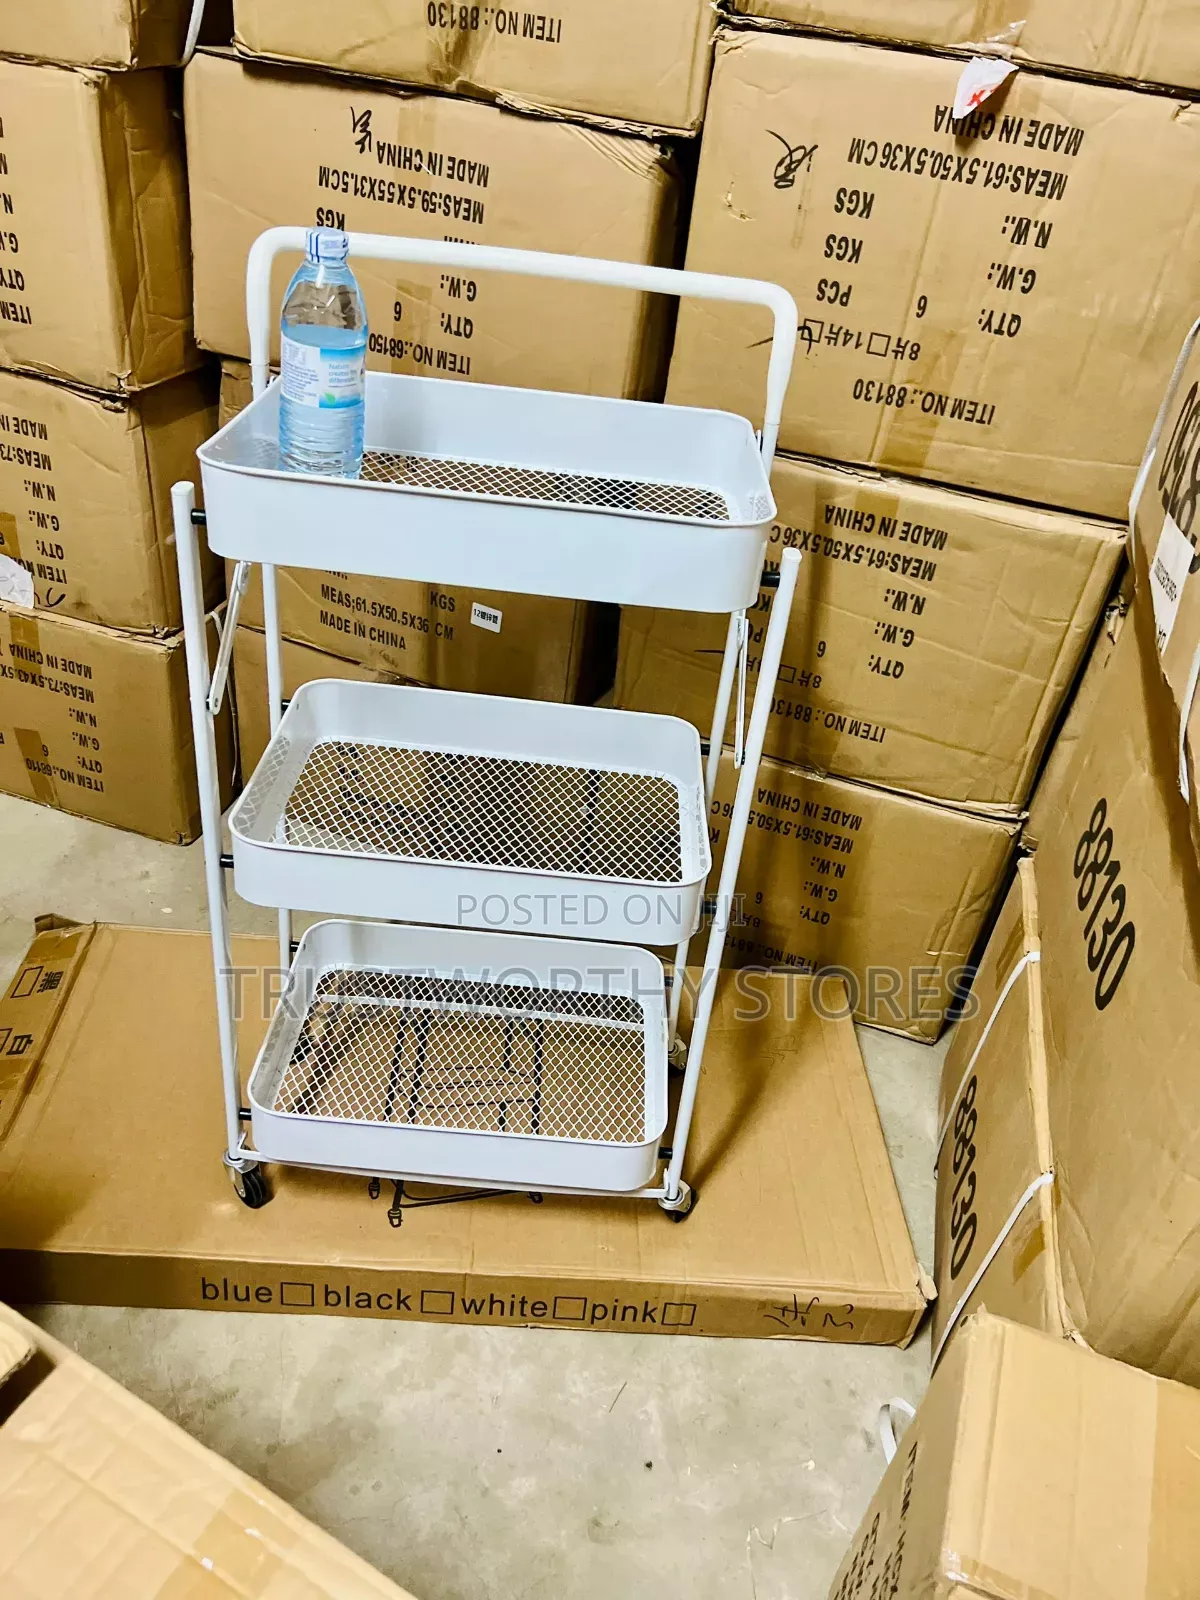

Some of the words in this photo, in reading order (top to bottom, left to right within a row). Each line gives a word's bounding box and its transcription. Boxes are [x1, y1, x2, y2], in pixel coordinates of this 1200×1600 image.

[427, 1, 479, 30] 88130
[523, 12, 561, 43] ITEM
[933, 104, 996, 141] CHINA
[998, 114, 1023, 145] IN
[1023, 119, 1085, 157] MADE
[376, 140, 423, 172] CHINA
[427, 151, 443, 177] IN
[446, 155, 489, 188] MADE
[834, 186, 875, 220] KGS
[316, 207, 345, 231] KGS
[1001, 214, 1053, 249] N.W.:
[823, 233, 863, 264] KGS
[440, 274, 477, 301] G.W.:
[987, 262, 1037, 295] G.W.:
[815, 278, 853, 307] PCS
[394, 301, 402, 321] 6
[915, 295, 928, 319] 6
[440, 312, 473, 339] QTY:
[977, 308, 1022, 338] QTY:
[436, 353, 471, 376] ITEM
[852, 378, 908, 409] 88130
[949, 399, 996, 426] ITEM
[13, 416, 48, 441] MADE
[24, 479, 56, 502] N.W.:
[28, 510, 60, 532] G.W.:
[824, 504, 876, 534] CHINA
[877, 515, 898, 539] IN
[898, 521, 948, 551] MADE
[36, 540, 64, 560] QTY:
[37, 561, 67, 585] ITEM
[429, 591, 456, 613] KGS
[319, 609, 351, 634] MADE
[353, 620, 366, 639] IN
[369, 626, 406, 650] CHINA
[434, 622, 454, 641] CM
[874, 621, 915, 648] G.W.:
[8, 643, 43, 665] CHINA
[46, 653, 59, 670] IN
[817, 640, 827, 658] 6
[61, 658, 92, 679] MADE
[867, 653, 905, 680] QTY:
[848, 719, 886, 743] ITEM
[41, 744, 49, 757] 6
[77, 755, 103, 774] QTY:
[77, 774, 104, 793] ITEM
[757, 787, 800, 813] CHINA
[803, 801, 820, 818] IN
[820, 805, 863, 832] MADE
[799, 905, 831, 926] QTY:
[1073, 797, 1135, 1011] 88130
[950, 1074, 978, 1281] 88130
[200, 1276, 274, 1304] blue
[323, 1283, 413, 1312] black
[461, 1292, 548, 1318] white
[590, 1297, 658, 1325] pink
